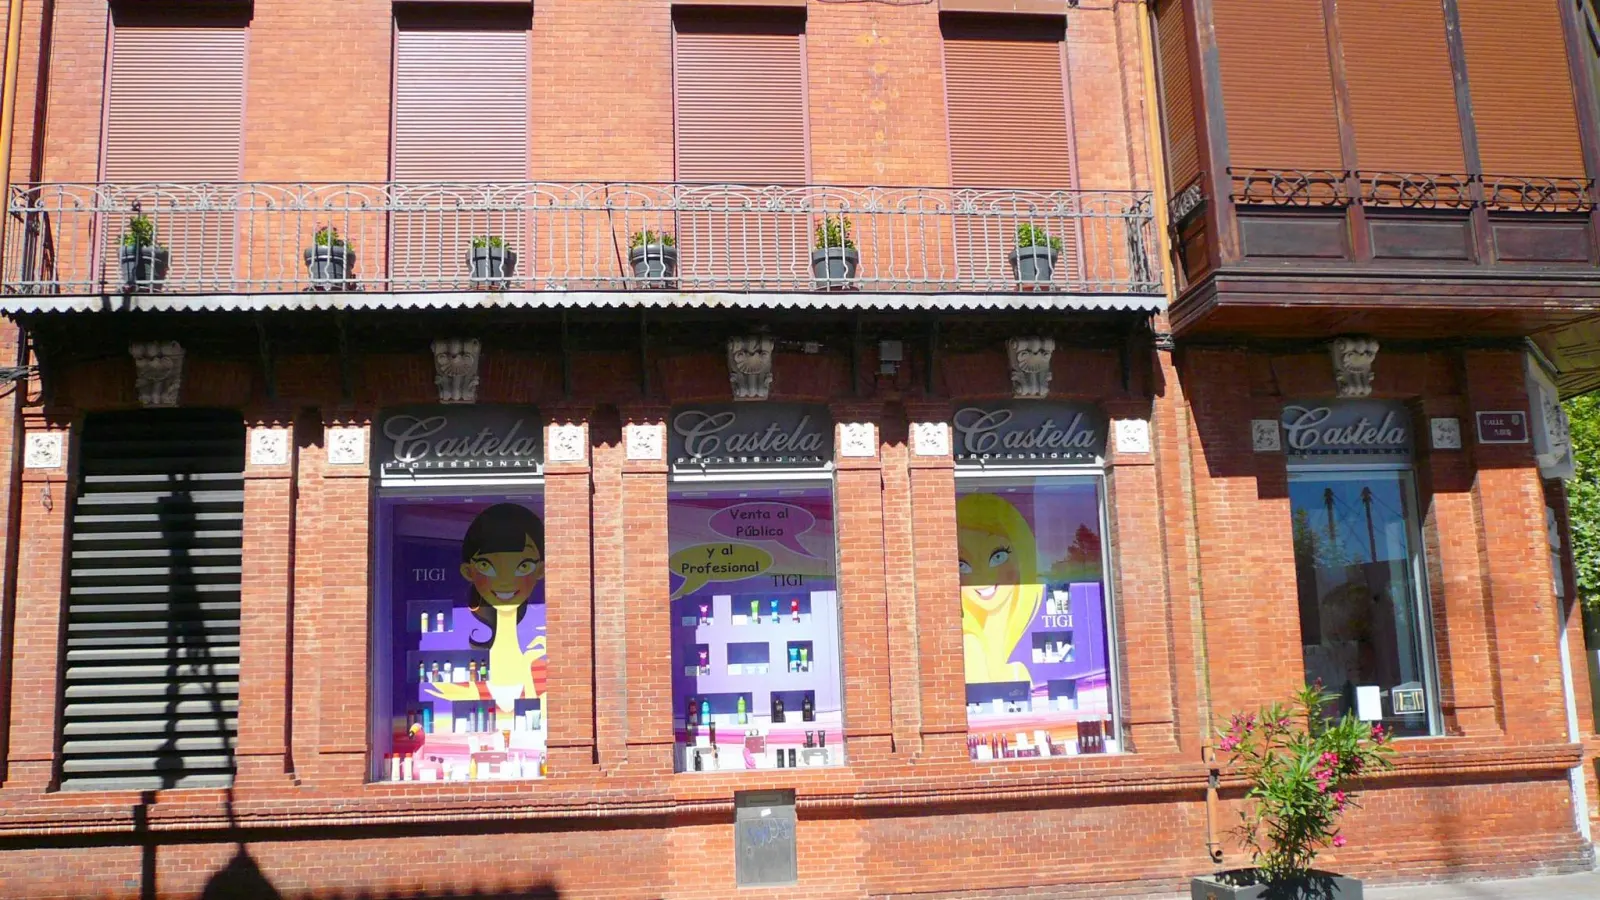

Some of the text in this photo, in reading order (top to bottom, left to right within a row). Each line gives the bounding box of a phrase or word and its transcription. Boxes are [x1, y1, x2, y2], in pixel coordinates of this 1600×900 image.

[953, 407, 1097, 454] Castela
[1281, 405, 1405, 450] Castela
[383, 414, 537, 463] Castela
[673, 410, 824, 459] Castela
[677, 456, 822, 464] PROFESSIONAL
[958, 452, 1095, 460] PROFESSIONAL
[385, 459, 536, 469] PROFESSIONAL
[729, 508, 789, 520] Venta al
[736, 526, 784, 537] Público
[706, 544, 733, 559] y al
[681, 561, 760, 574] Profesional
[412, 568, 447, 582] TIGI
[771, 574, 804, 588] TIGI
[1041, 615, 1074, 628] TIGI
